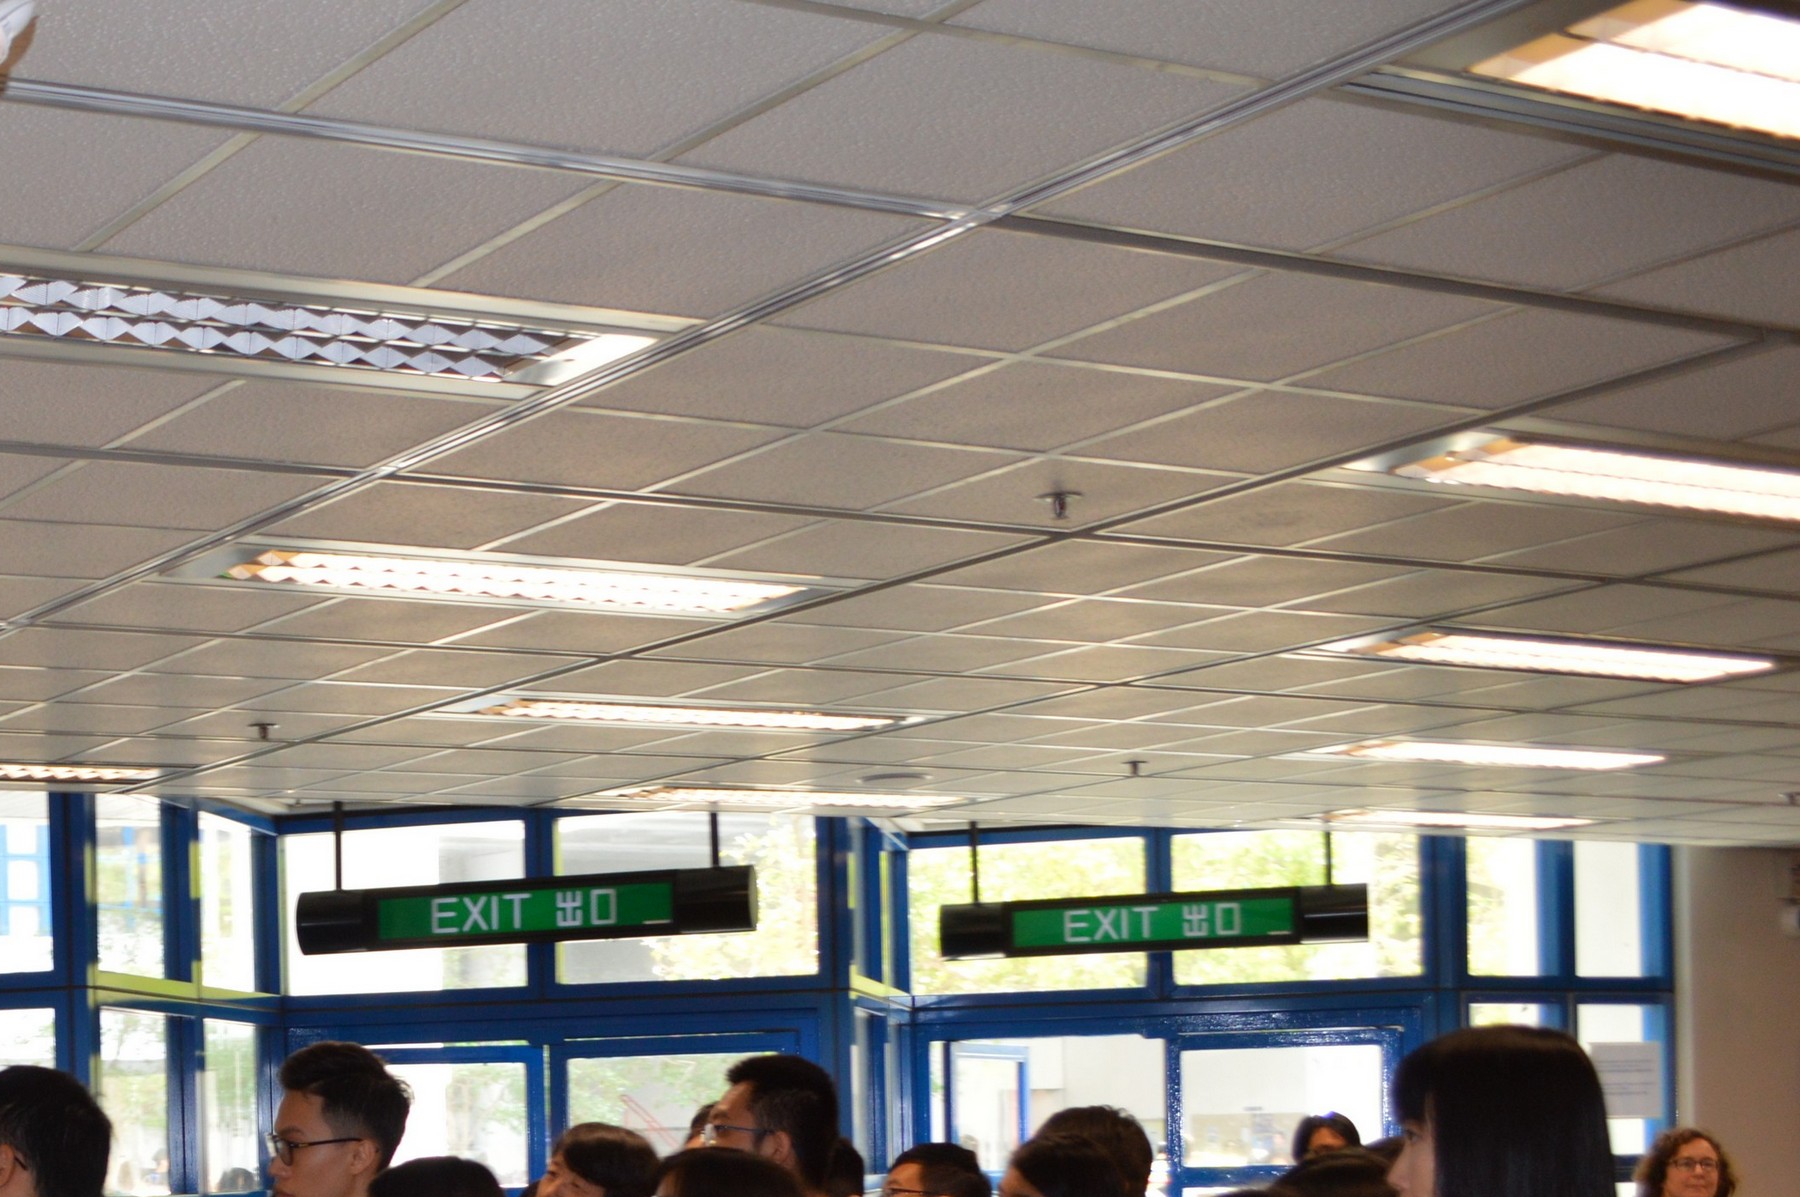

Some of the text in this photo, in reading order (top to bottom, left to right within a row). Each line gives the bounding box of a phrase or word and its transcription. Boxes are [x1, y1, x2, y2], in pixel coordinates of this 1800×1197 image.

[431, 888, 618, 934] EXIT 出口
[1063, 902, 1242, 943] EXIT 出口
